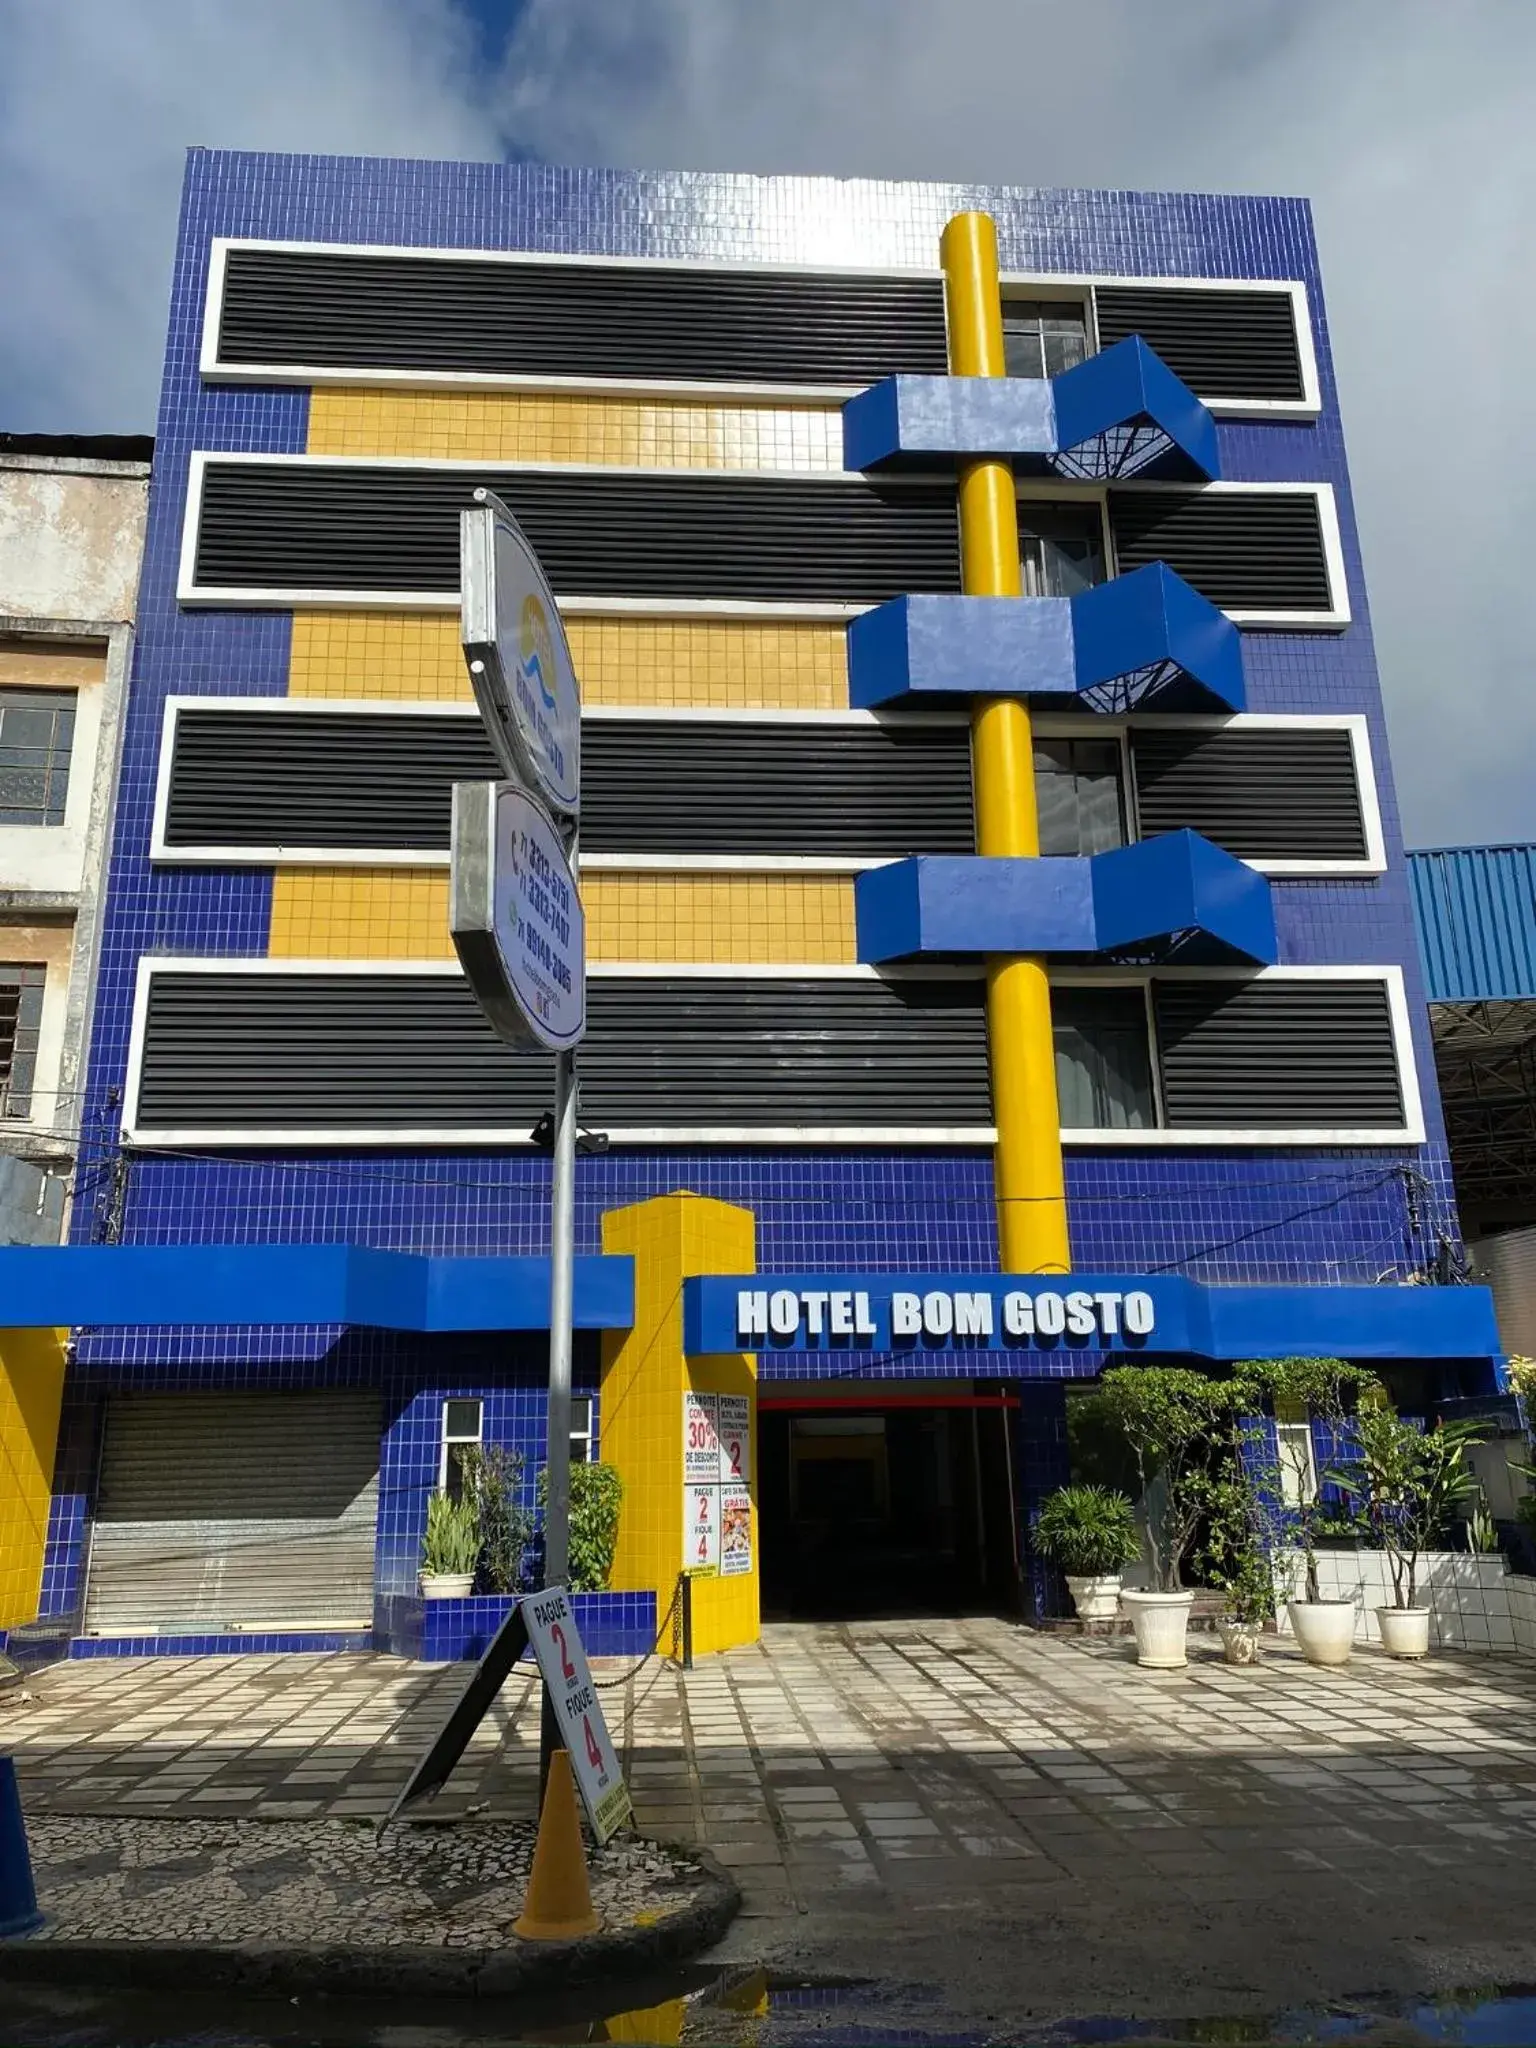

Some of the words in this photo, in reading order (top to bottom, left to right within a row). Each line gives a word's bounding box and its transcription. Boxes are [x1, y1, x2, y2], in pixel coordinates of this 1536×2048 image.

[737, 1290, 877, 1335] HOTEL
[892, 1292, 993, 1335] BOM
[1003, 1291, 1155, 1336] GOSTO
[687, 1395, 716, 1407] PERNOITE
[721, 1397, 748, 1409] PERNOITE
[689, 1422, 717, 1449] 30%
[730, 1441, 742, 1474] 2
[694, 1488, 713, 1497] PAGUE
[700, 1497, 708, 1519] 2
[694, 1526, 712, 1534] FIQUE
[698, 1535, 708, 1559] 4
[534, 1597, 568, 1628] PAGUE
[551, 1624, 575, 1680] 2
[565, 1687, 593, 1719] FIQUE
[583, 1714, 604, 1773] 4
